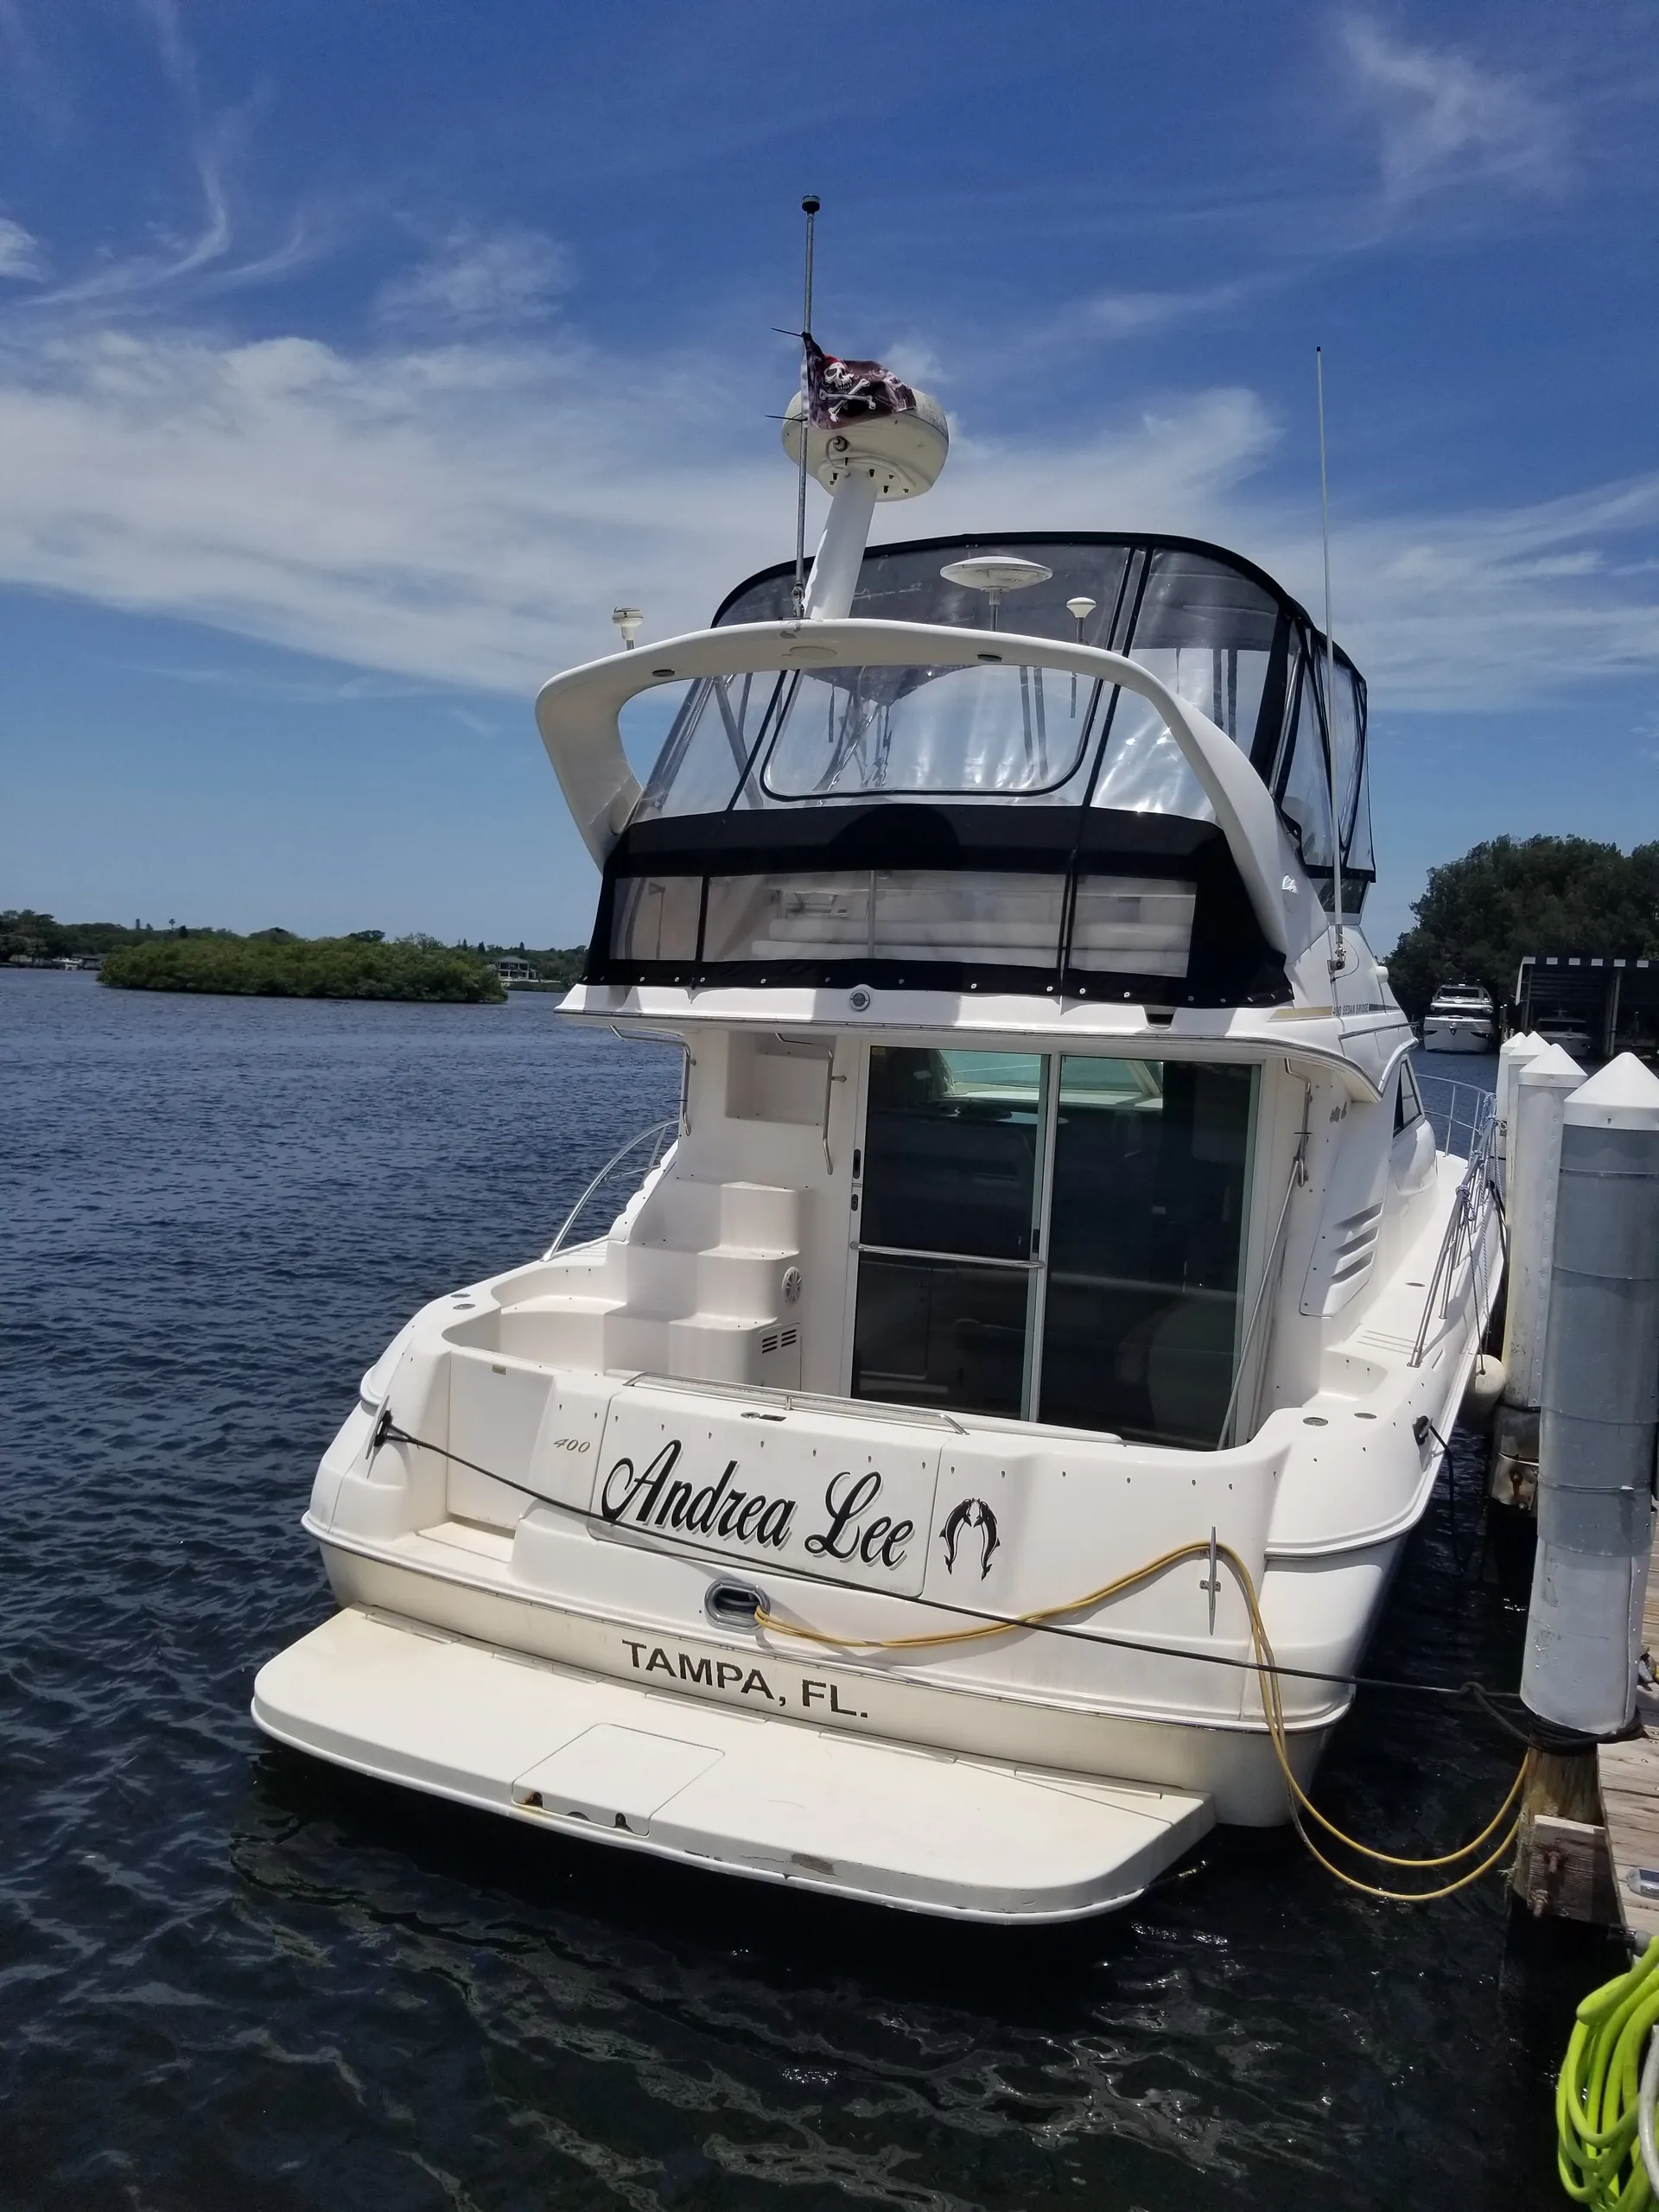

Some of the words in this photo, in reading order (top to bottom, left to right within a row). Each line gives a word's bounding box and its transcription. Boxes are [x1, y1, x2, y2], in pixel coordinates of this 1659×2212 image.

[553, 1438, 591, 1453] 400
[601, 1439, 797, 1549] Andrea
[804, 1471, 915, 1569] Lee
[621, 1639, 787, 1707] TAMPA,
[800, 1679, 869, 1719] FL.
